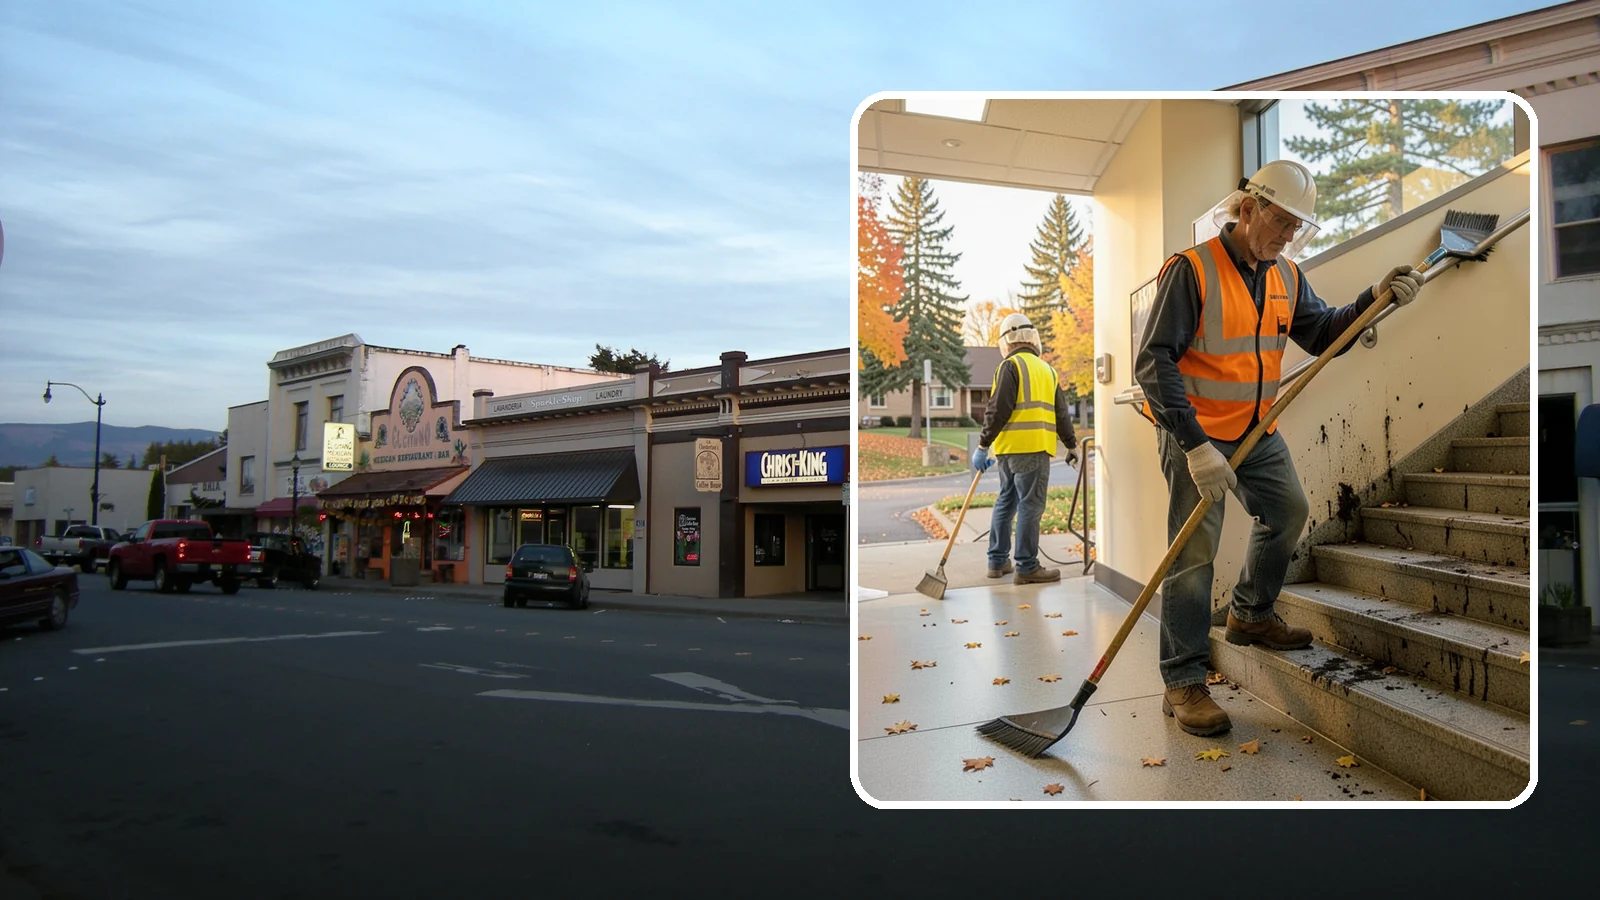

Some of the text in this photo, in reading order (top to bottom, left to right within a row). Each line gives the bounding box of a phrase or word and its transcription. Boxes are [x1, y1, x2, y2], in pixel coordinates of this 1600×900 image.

[530, 394, 582, 409] Sparkle Shop
[595, 389, 624, 400] LAUNDRY
[493, 402, 523, 413] LAVANDERIA
[391, 425, 402, 449] EL
[373, 455, 396, 464] MEXICAN
[397, 451, 433, 462] RESTAURANT
[437, 450, 450, 459] BAR
[760, 450, 827, 478] CHRIST KING
